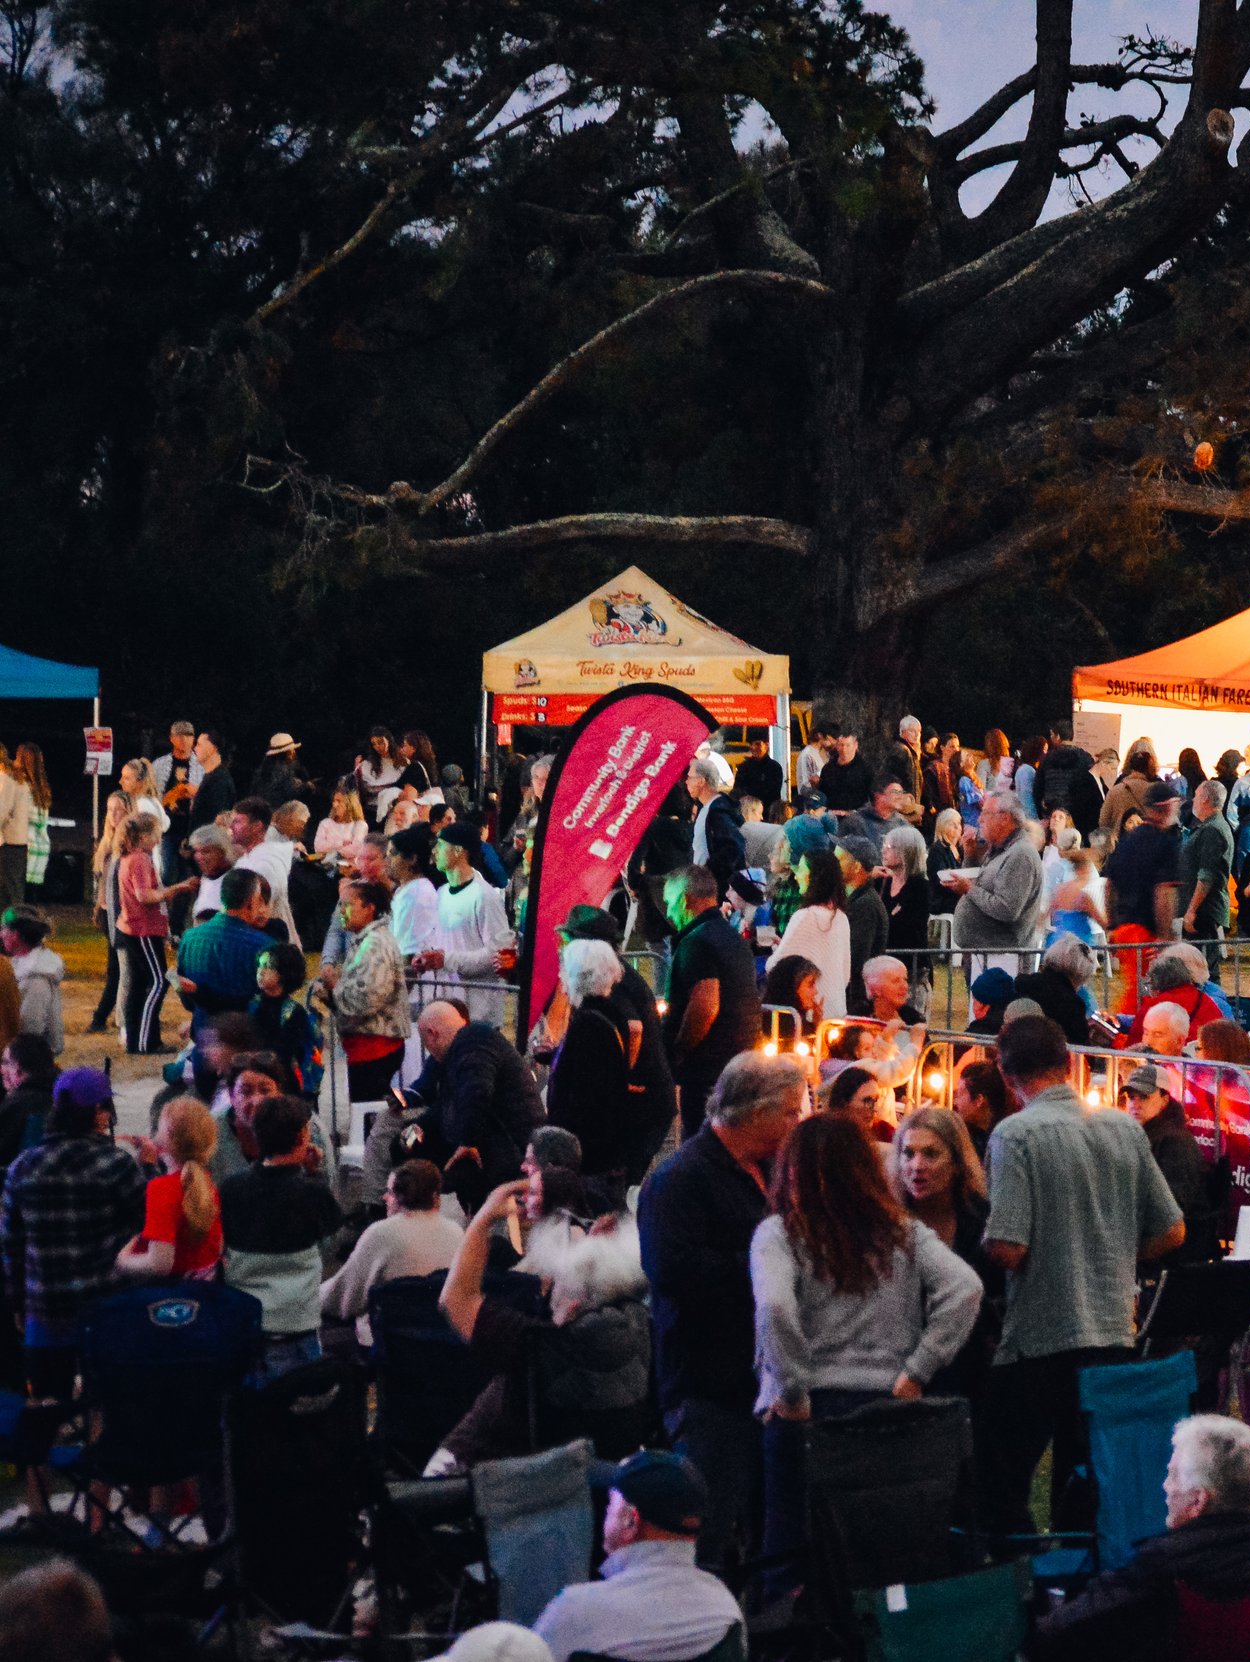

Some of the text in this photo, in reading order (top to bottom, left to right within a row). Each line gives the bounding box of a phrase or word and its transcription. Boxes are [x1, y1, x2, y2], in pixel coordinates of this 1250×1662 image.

[620, 661, 654, 680] King
[658, 661, 696, 680] Spuds
[1106, 679, 1168, 700] SOUTHERN
[1172, 684, 1218, 704] ITALIAN
[623, 731, 651, 769] District
[563, 725, 636, 829] Community Bank
[606, 741, 678, 838] Bendigo Bank
